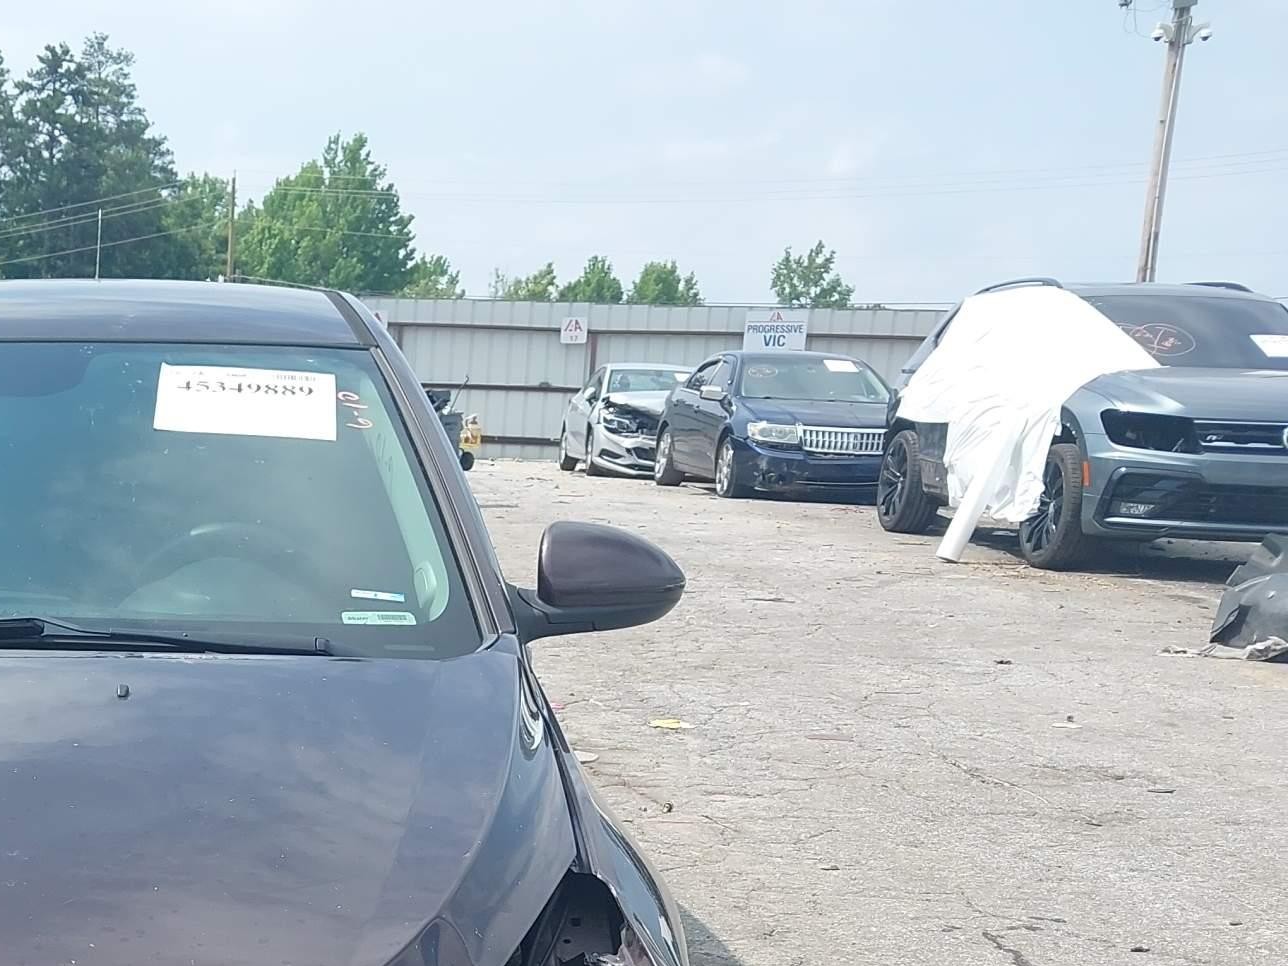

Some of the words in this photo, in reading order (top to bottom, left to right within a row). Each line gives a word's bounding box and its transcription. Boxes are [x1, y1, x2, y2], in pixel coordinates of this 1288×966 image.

[747, 324, 804, 334] PROGRESSIVE
[763, 334, 786, 347] VIC
[176, 380, 314, 397] 45349889
